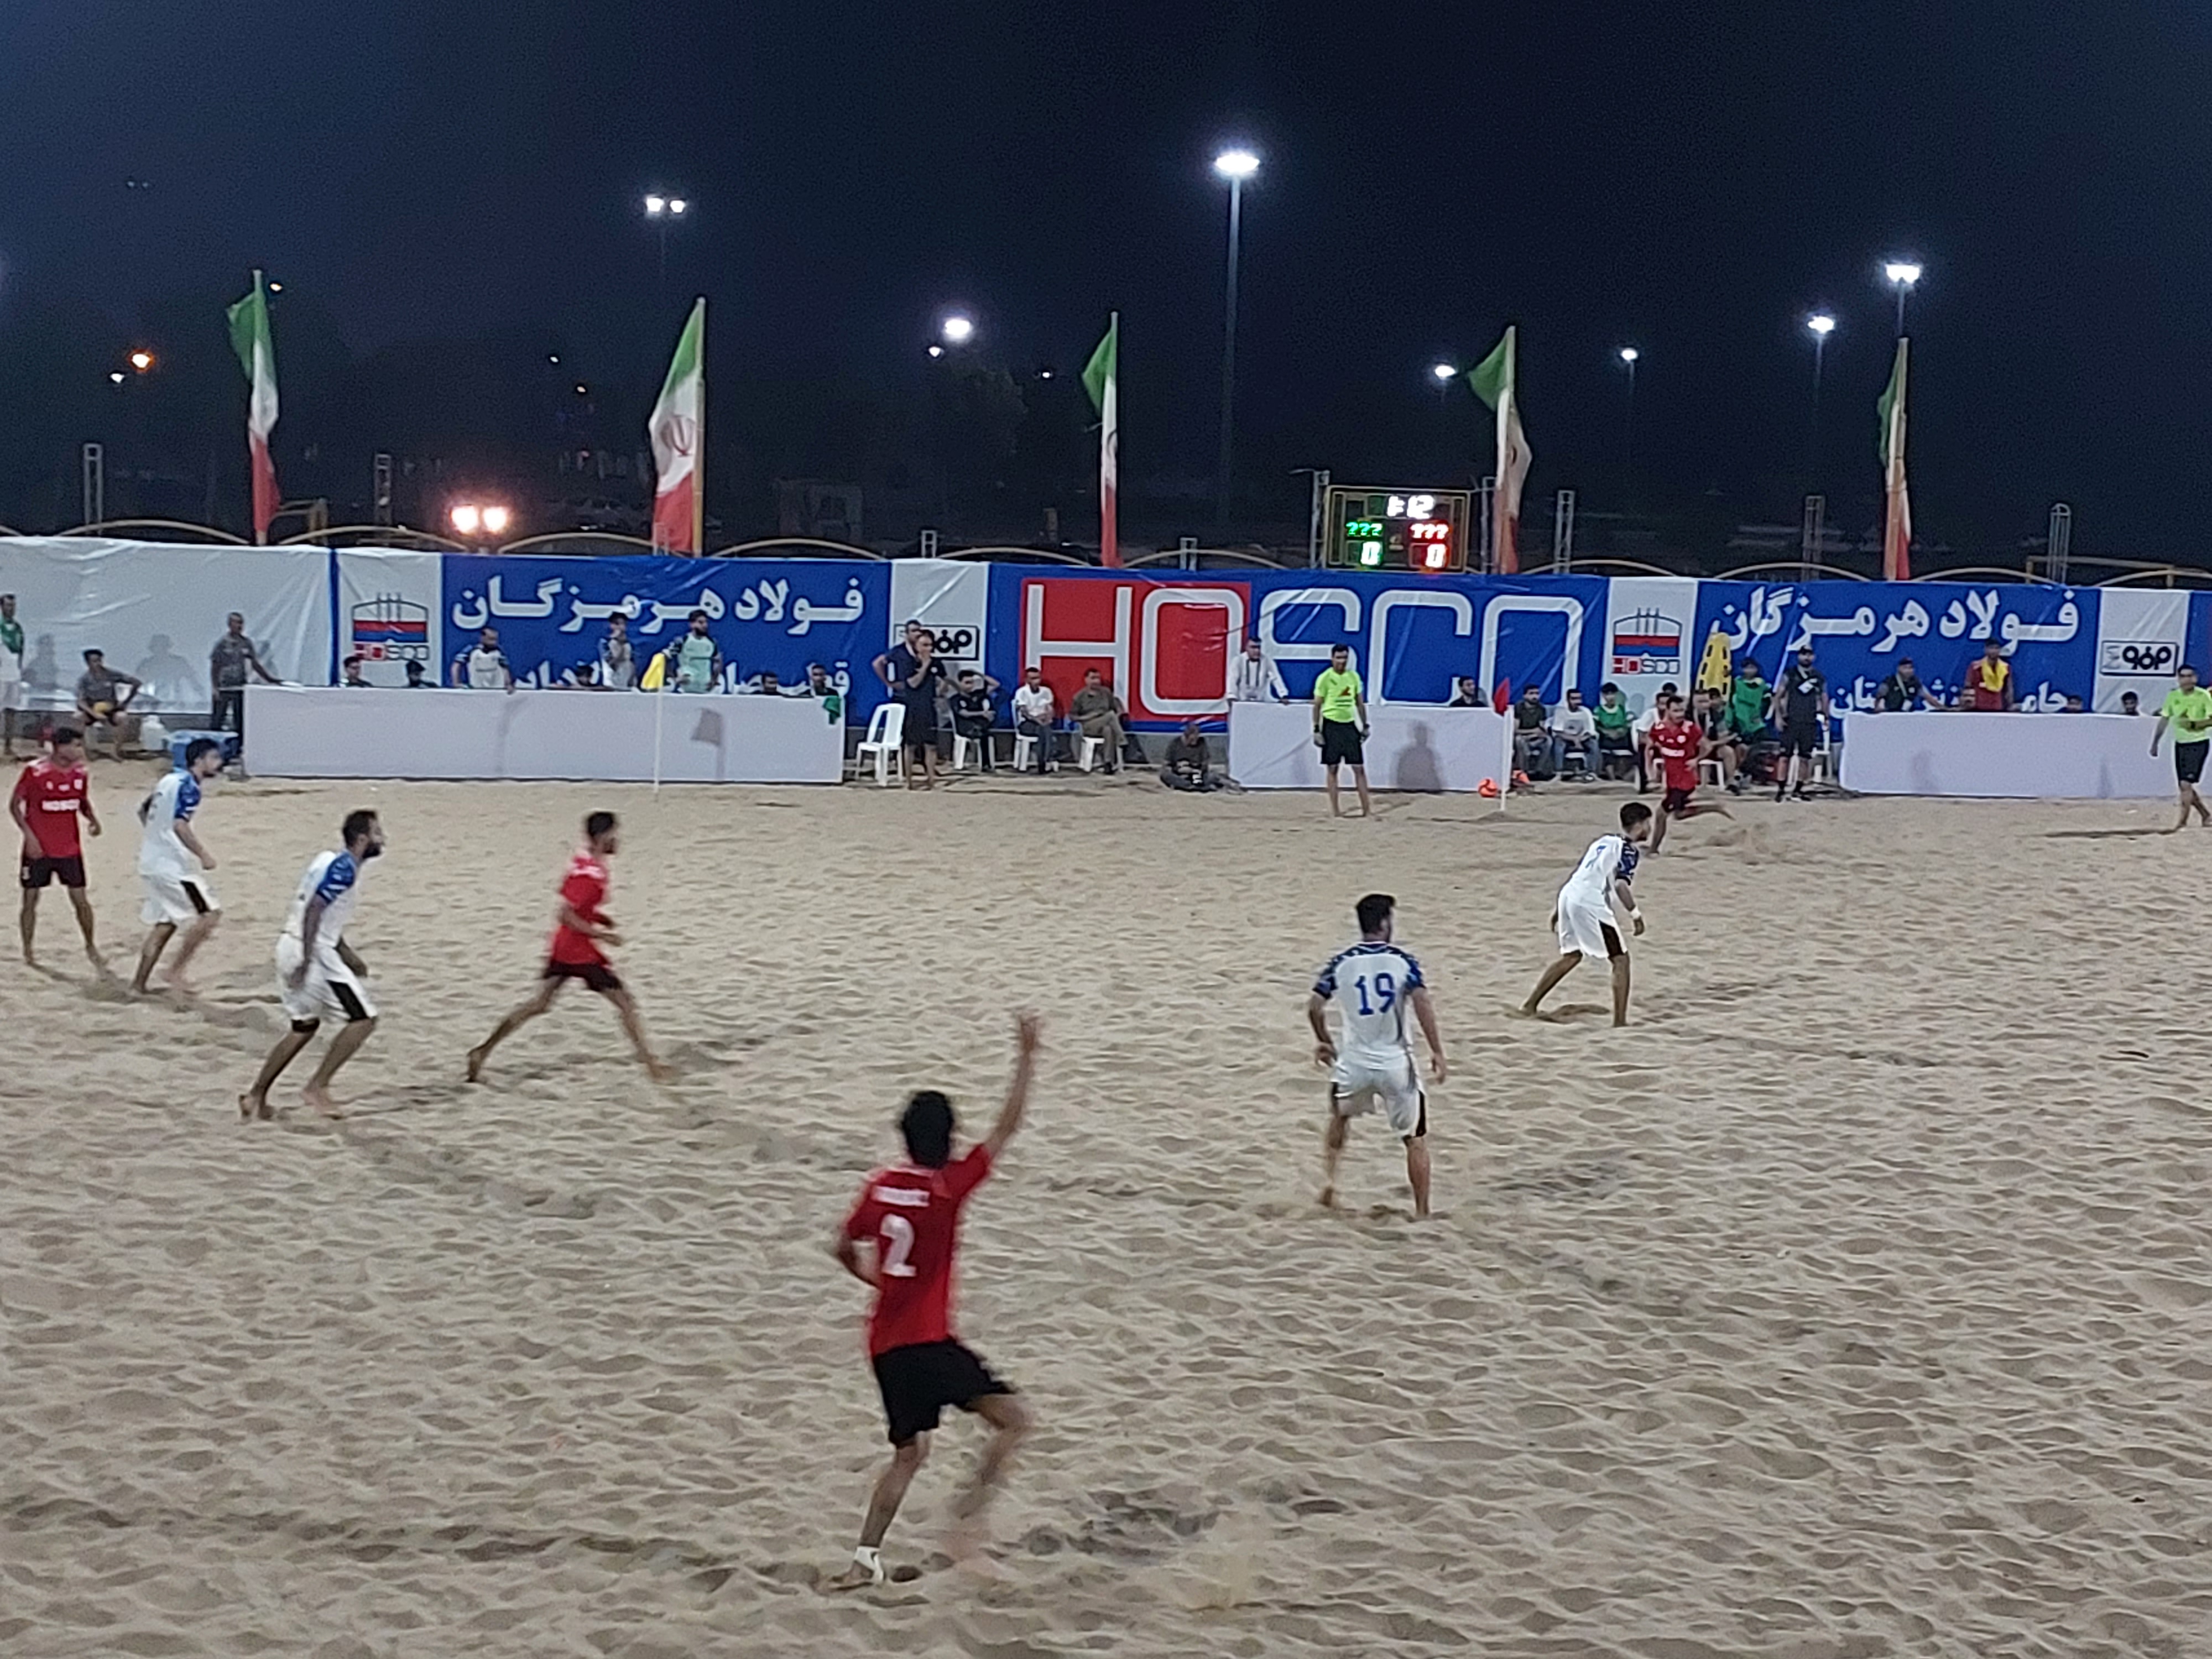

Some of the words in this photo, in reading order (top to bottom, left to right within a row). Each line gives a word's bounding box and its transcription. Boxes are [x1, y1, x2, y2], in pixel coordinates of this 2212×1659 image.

[1360, 541, 1381, 566] 0
[1425, 544, 1447, 568] 0
[453, 575, 725, 634] هرمزگان
[735, 577, 864, 635] فولاد
[1939, 589, 2079, 656] فولاد
[1025, 583, 1584, 714] HOSCO
[1355, 973, 1396, 1016] 19
[880, 1213, 917, 1277] 2
